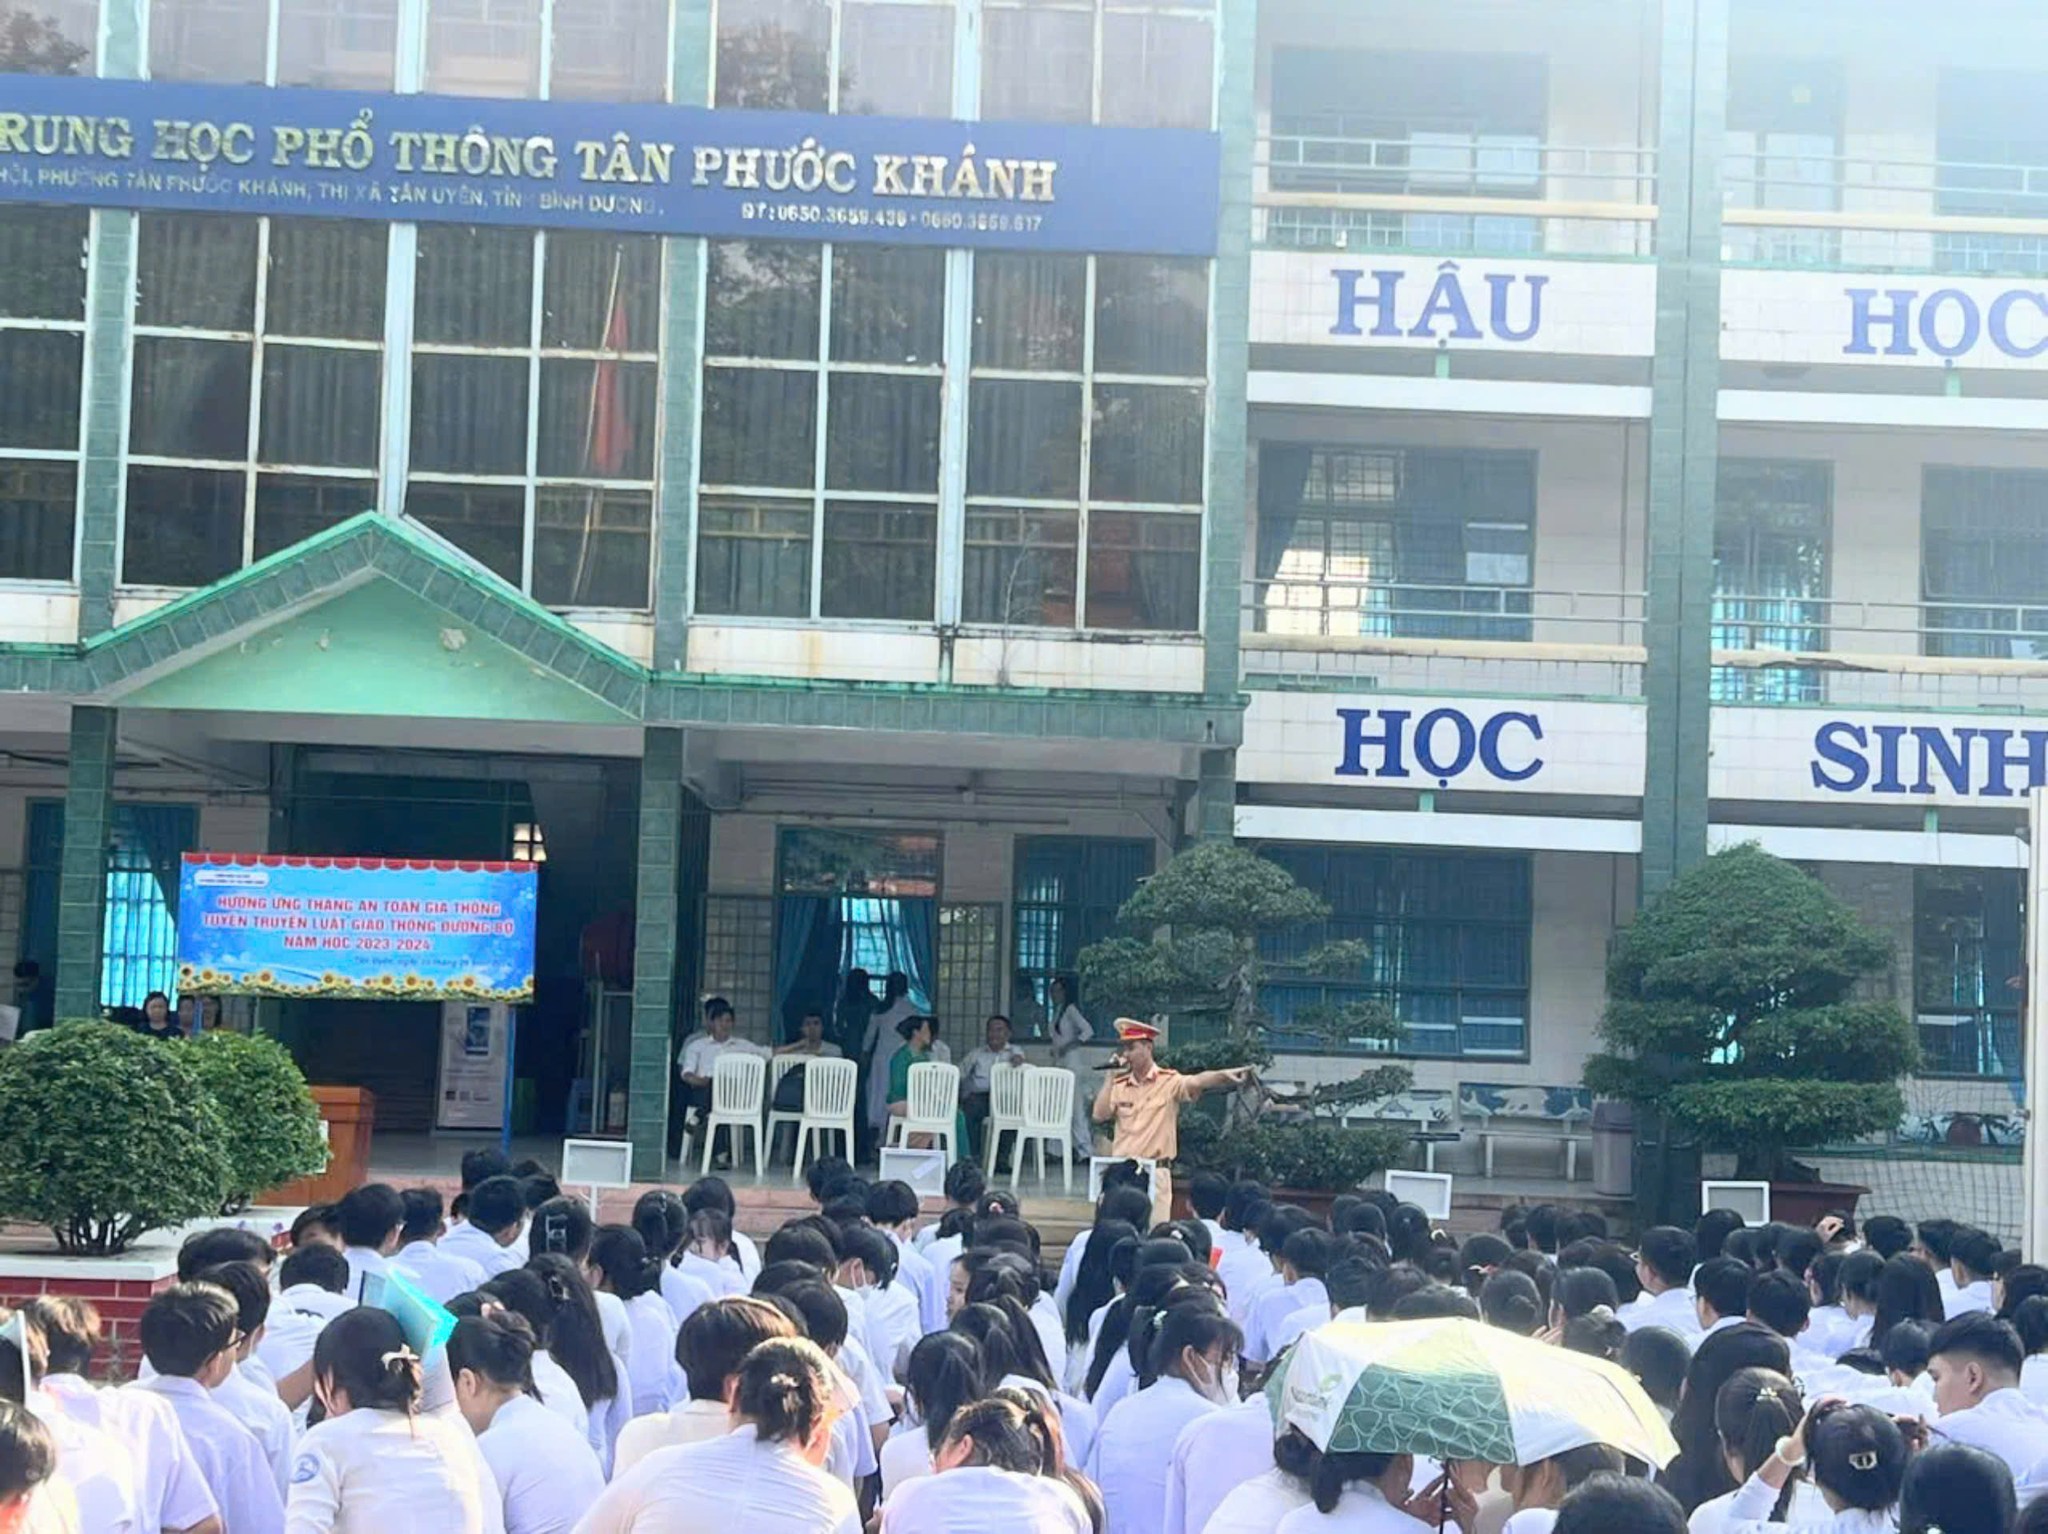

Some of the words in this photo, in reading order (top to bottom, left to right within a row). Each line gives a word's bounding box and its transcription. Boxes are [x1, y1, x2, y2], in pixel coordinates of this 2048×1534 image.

[0, 112, 134, 158] RUNG
[151, 119, 255, 172] HỌC
[271, 108, 374, 171] PHỔ
[389, 124, 559, 179] THÔNG
[574, 131, 675, 185] TÂN
[692, 137, 857, 194] PHƯỚC
[873, 142, 1057, 202] KHÁNH
[38, 165, 118, 188] PHƯNG
[493, 184, 531, 208] TỈN
[1329, 260, 1549, 349] HẬU
[1842, 288, 2048, 369] HỌC
[1334, 707, 1543, 788] HỌC
[1811, 721, 2048, 797] SINH
[351, 918, 385, 931] GIAO
